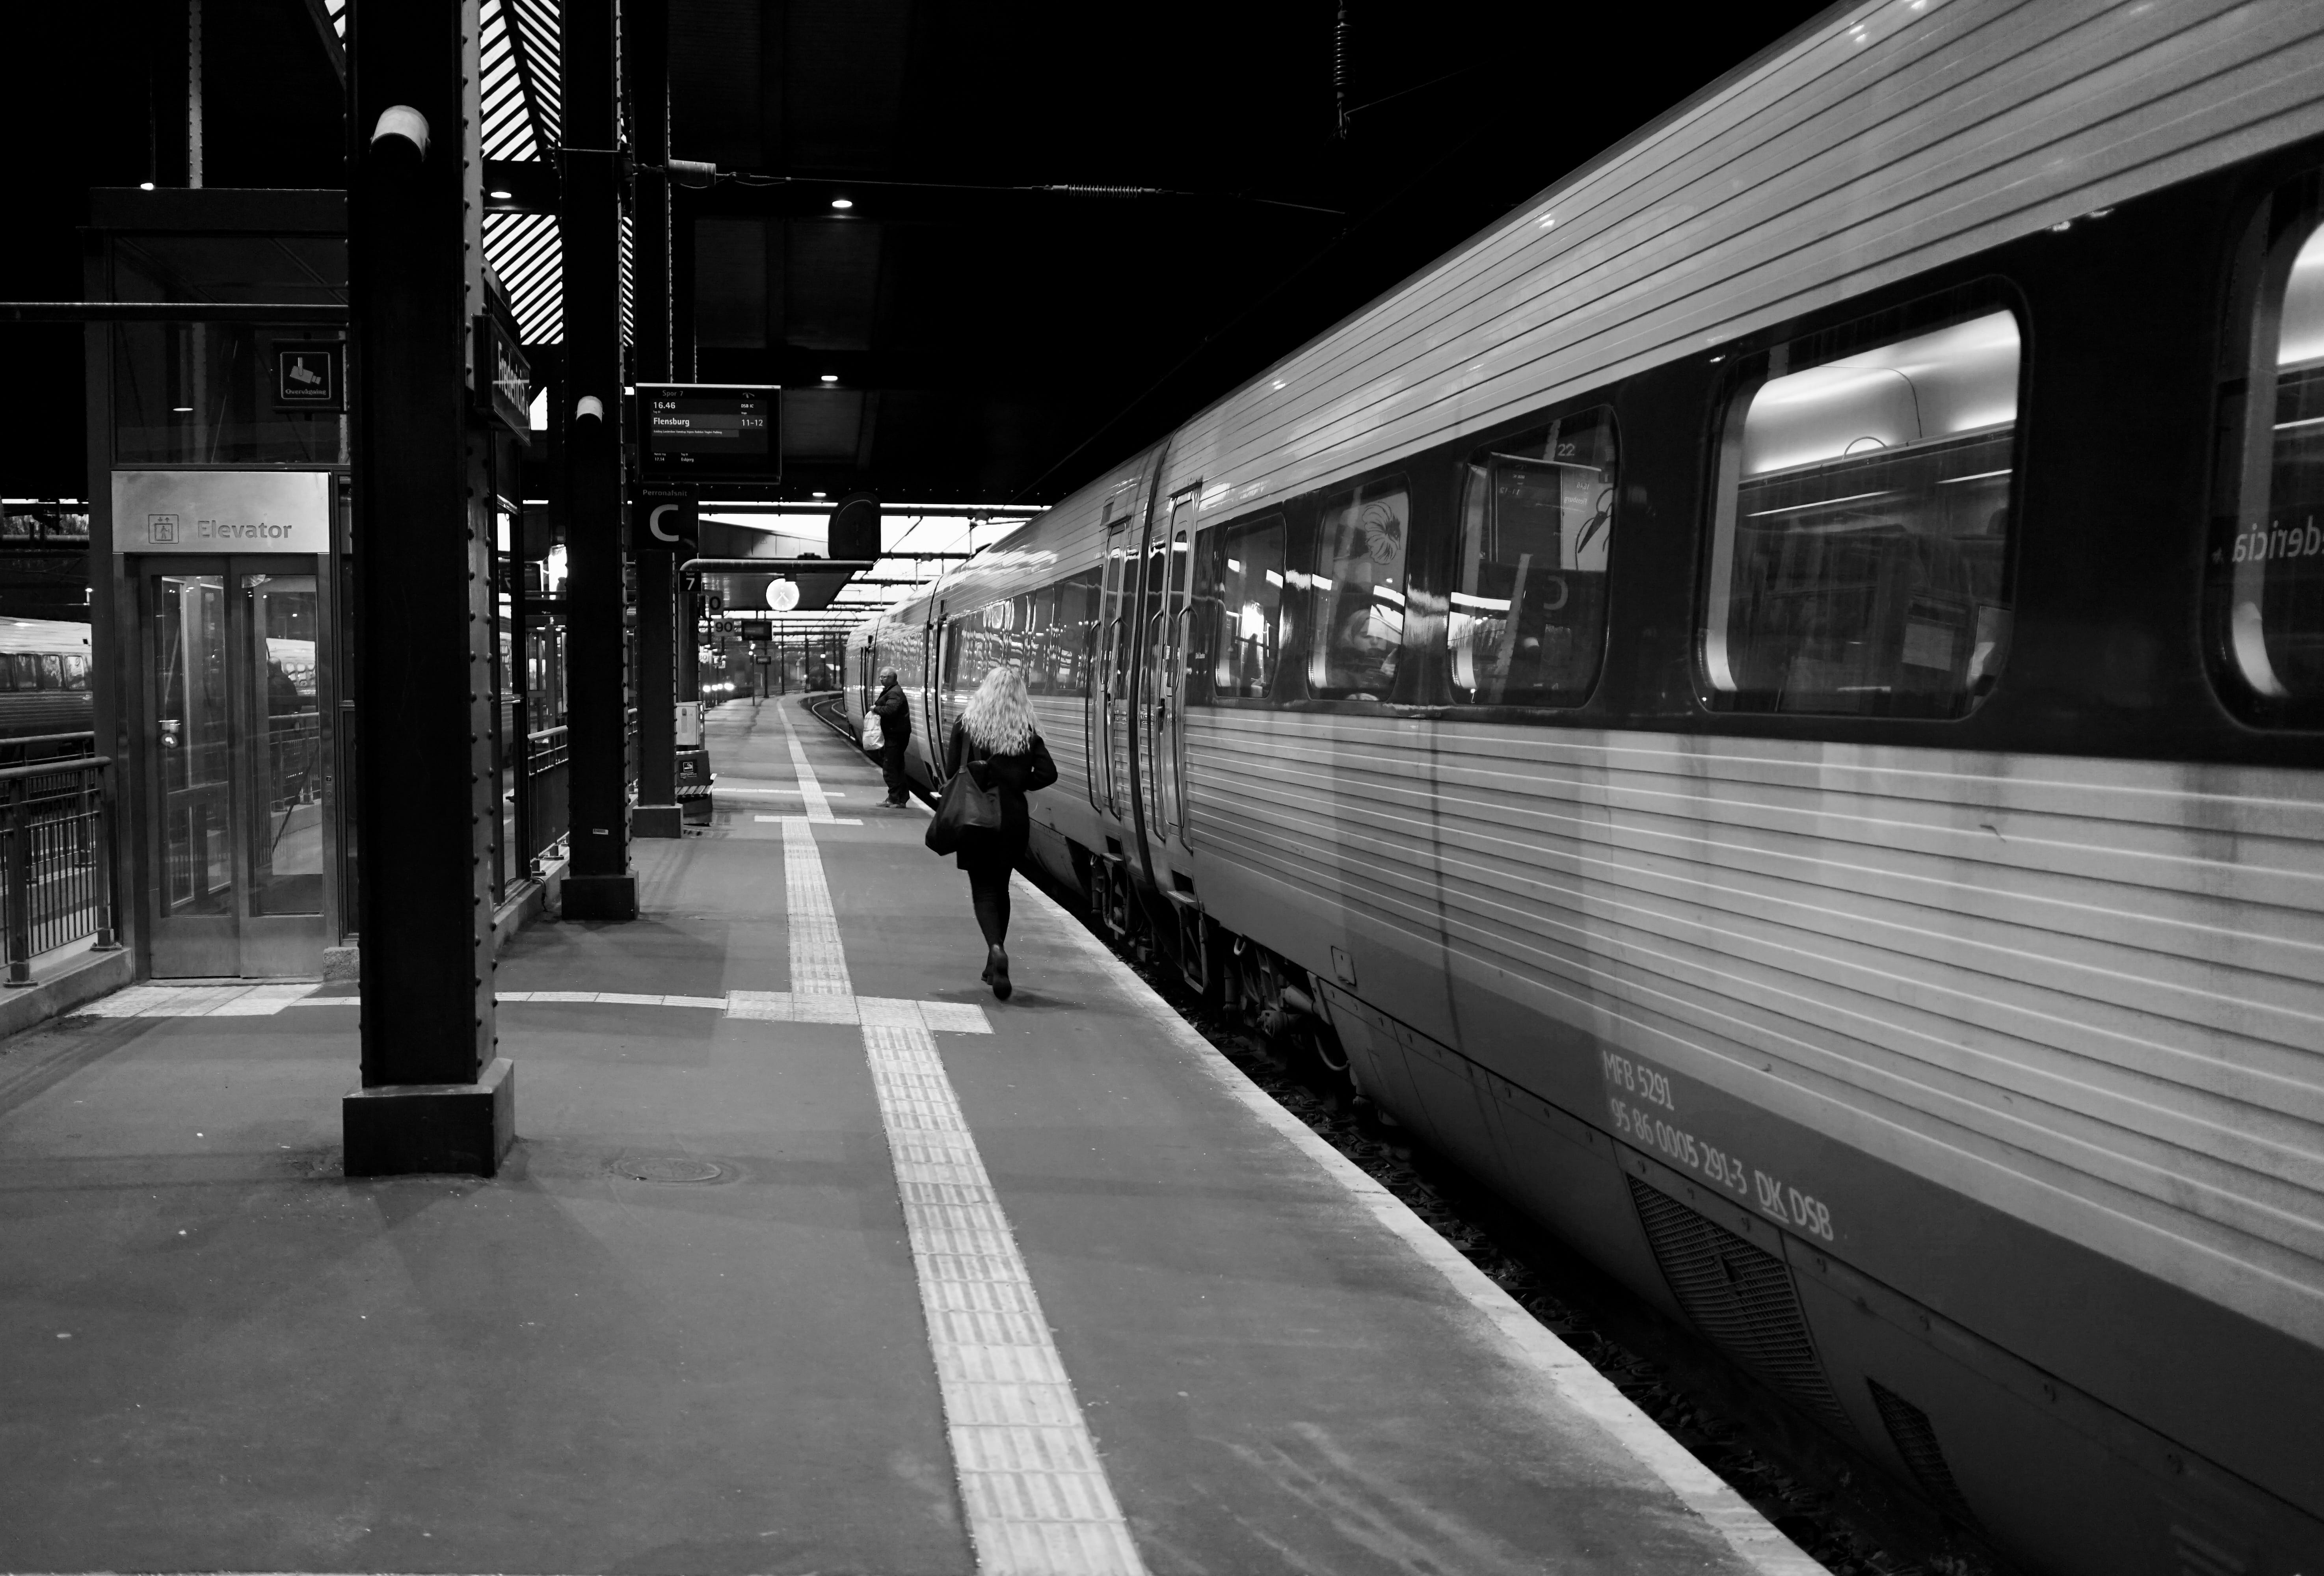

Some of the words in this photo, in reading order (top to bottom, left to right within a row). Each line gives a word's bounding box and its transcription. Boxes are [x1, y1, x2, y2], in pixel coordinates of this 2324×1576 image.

[498, 340, 525, 416] Fredericia
[653, 417, 690, 427] Flensburg
[1558, 443, 1575, 456] 22
[197, 520, 292, 538] Elevator
[649, 504, 679, 542] C
[686, 578, 695, 591] 7
[715, 621, 733, 632] 90
[1603, 1050, 1635, 1091] MFB
[1637, 1065, 1675, 1111] 5291
[1610, 1098, 1630, 1132] 95
[1632, 1108, 1654, 1145] 86
[1656, 1120, 1699, 1168] 0005
[1699, 1141, 1747, 1195] 291-3
[1754, 1169, 1789, 1223] DK
[1788, 1187, 1834, 1241] DSB
